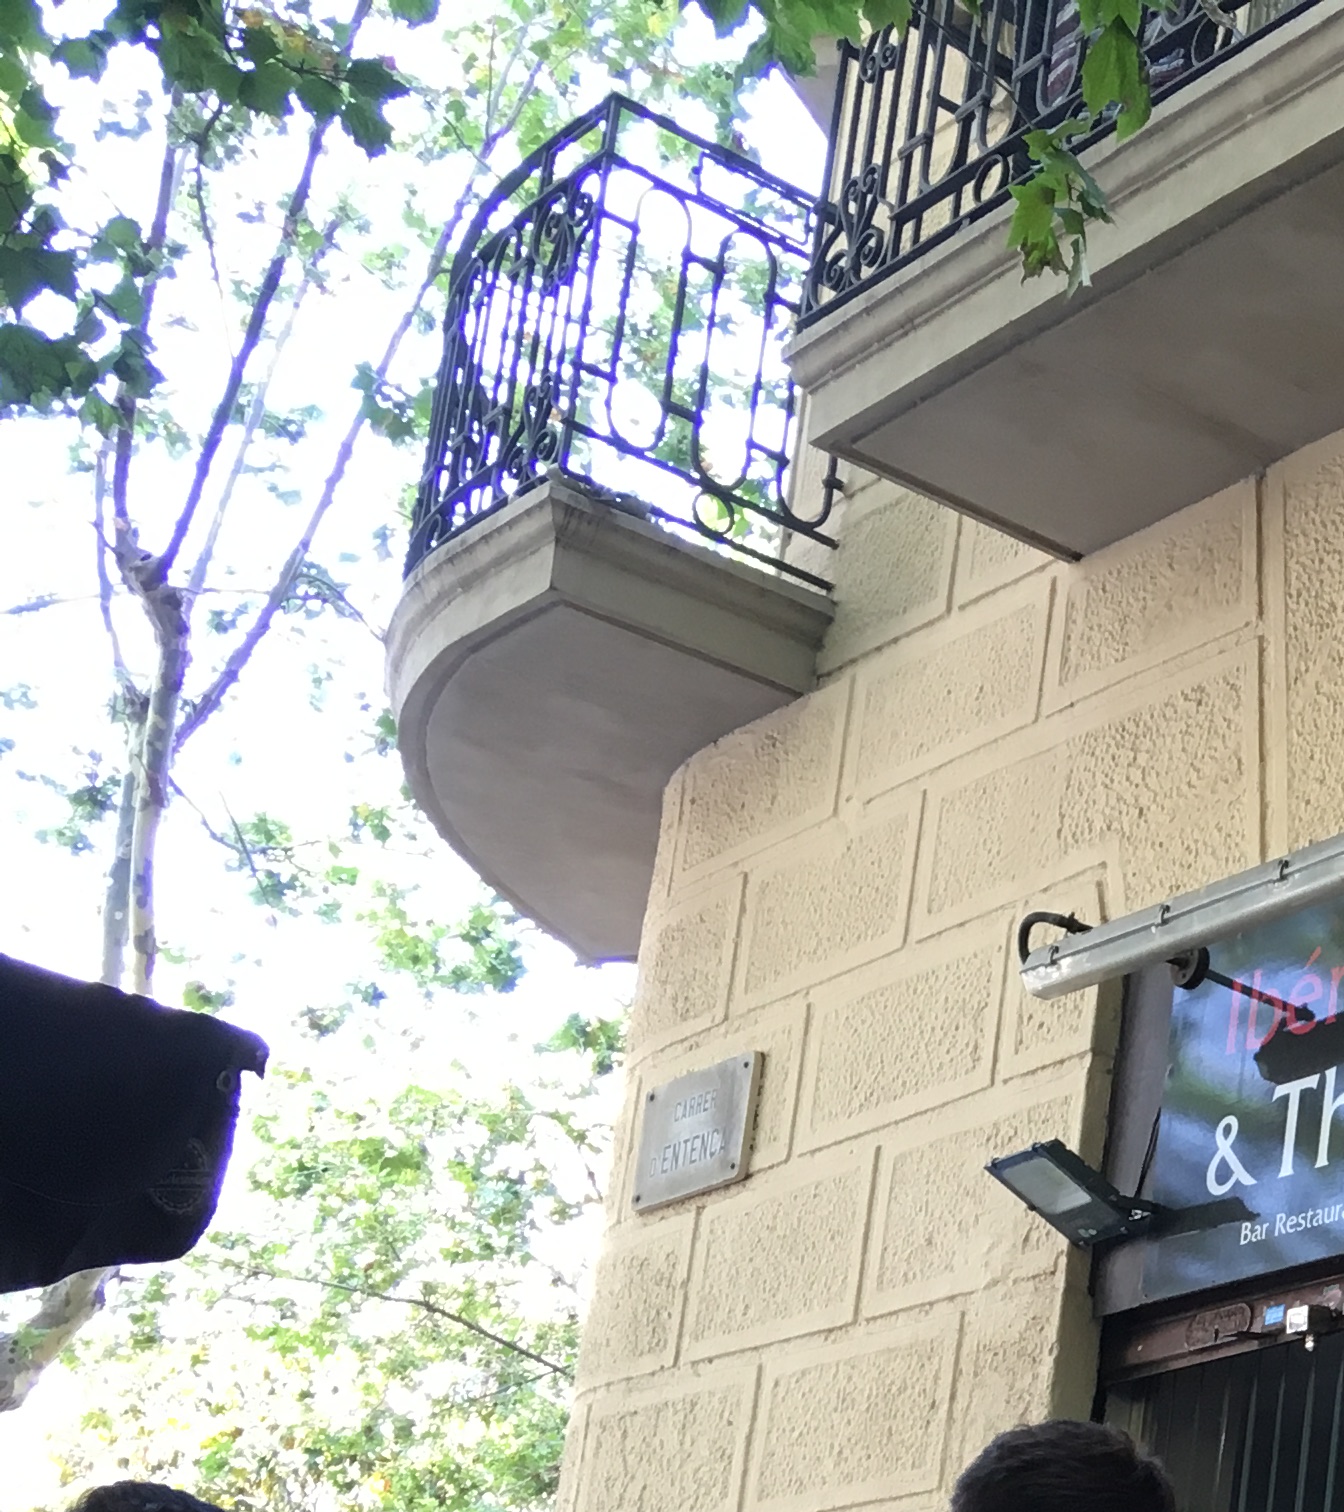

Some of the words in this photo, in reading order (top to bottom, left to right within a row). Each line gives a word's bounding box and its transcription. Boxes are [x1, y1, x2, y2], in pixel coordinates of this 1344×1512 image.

[673, 1088, 718, 1123] CARRER
[1206, 1114, 1258, 1196] &
[1239, 1221, 1270, 1245] Bar
